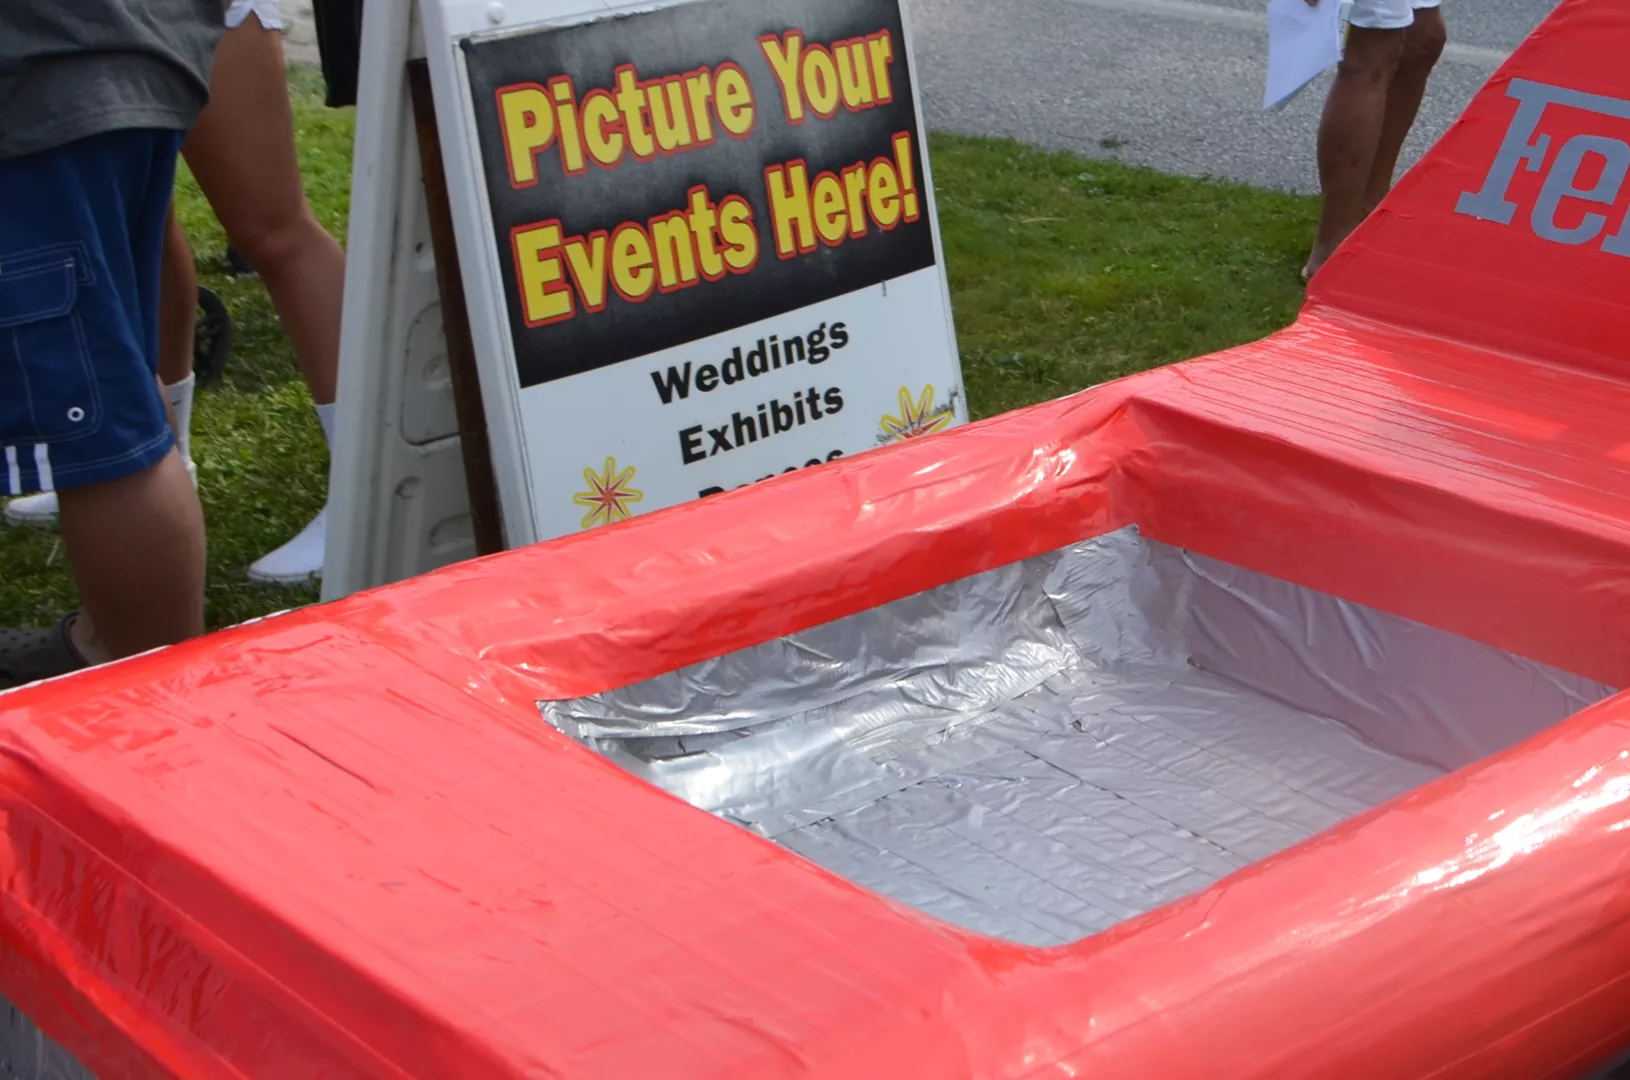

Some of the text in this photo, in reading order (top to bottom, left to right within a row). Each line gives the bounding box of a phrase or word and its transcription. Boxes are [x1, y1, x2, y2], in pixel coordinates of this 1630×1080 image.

[496, 29, 893, 189] Picture Your
[510, 130, 919, 328] Events Here!
[650, 320, 849, 405] Weddings
[678, 385, 844, 465] Exhibits
